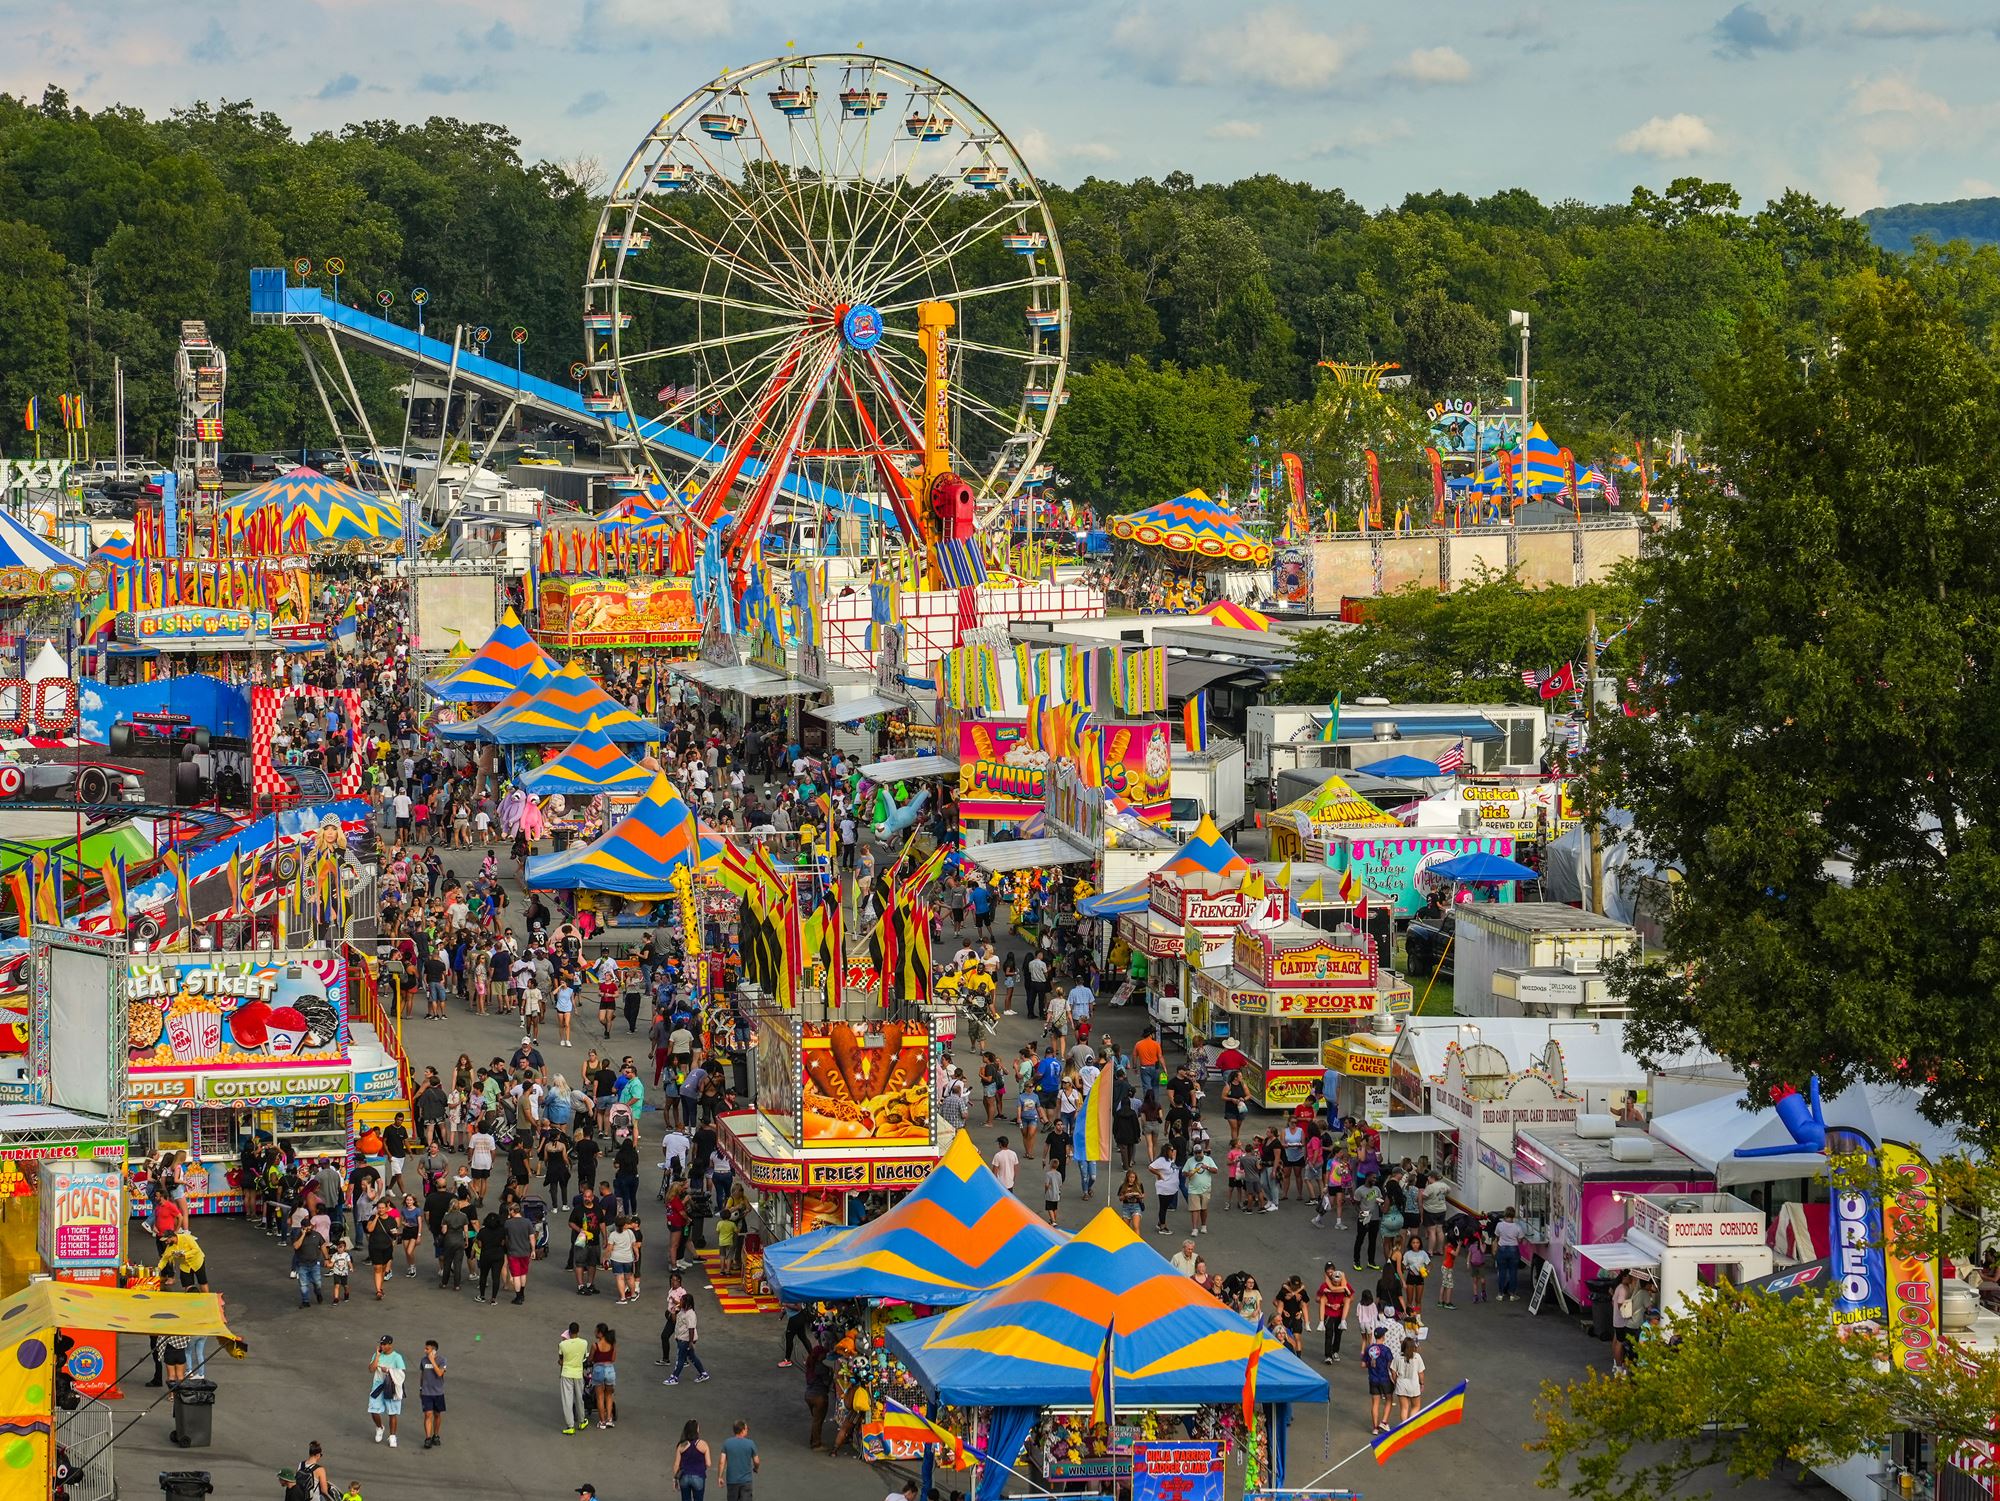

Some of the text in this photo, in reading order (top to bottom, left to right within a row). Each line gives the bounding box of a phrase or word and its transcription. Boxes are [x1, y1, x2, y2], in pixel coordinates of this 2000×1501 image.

[937, 330, 947, 376] ROCK
[937, 389, 947, 446] STAR
[0, 459, 71, 489] XY
[144, 613, 202, 634] RISING
[584, 635, 608, 644] CHICKEN
[608, 635, 617, 643] ON
[629, 634, 645, 643] STICK
[652, 634, 684, 643] RIBBON
[136, 713, 188, 721] FLAMENGO
[1289, 724, 1311, 742] WILSON
[974, 760, 1046, 798] FUNNE
[1463, 787, 1519, 801] Chicken
[1317, 801, 1380, 822] LEMONADE
[1517, 821, 1534, 829] ICED
[1375, 848, 1396, 860] The
[1363, 862, 1408, 877] Teenage
[1366, 876, 1405, 890] Baker
[1189, 902, 1244, 918] FRENCH
[1280, 961, 1363, 976] CANDY SHACK
[185, 968, 277, 1001] STREET
[1349, 1055, 1388, 1067] FUNNEL
[372, 1070, 394, 1081] COLD
[1352, 1064, 1385, 1075] CAKES
[0, 1086, 24, 1094] OLD
[214, 1077, 343, 1096] COTTON CANDY
[1368, 1087, 1386, 1096] Sweet
[1505, 1080, 1517, 1100] FUNNEL
[1372, 1095, 1383, 1105] Tea
[1483, 1108, 1577, 1124] FRIED CANDY FUNNEL CAKES FRIED COOKIES
[0, 1146, 79, 1161] TURKEY LEGS
[93, 1145, 125, 1156] LEMONADE
[772, 1167, 799, 1181] STEAK
[813, 1166, 865, 1182] FRIES
[876, 1164, 931, 1180] NACHOS
[56, 1186, 118, 1226] TICKETS
[1675, 1222, 1758, 1236] FOOTLONG CORNDOG
[1838, 1191, 1871, 1302] OREO
[1832, 1306, 1882, 1326] Cookies
[1146, 1450, 1211, 1461] NINJA WARRIOR
[1068, 1467, 1087, 1476] WIN
[1088, 1466, 1108, 1475] LIVE
[1149, 1462, 1208, 1474] LADDER CLIMB
